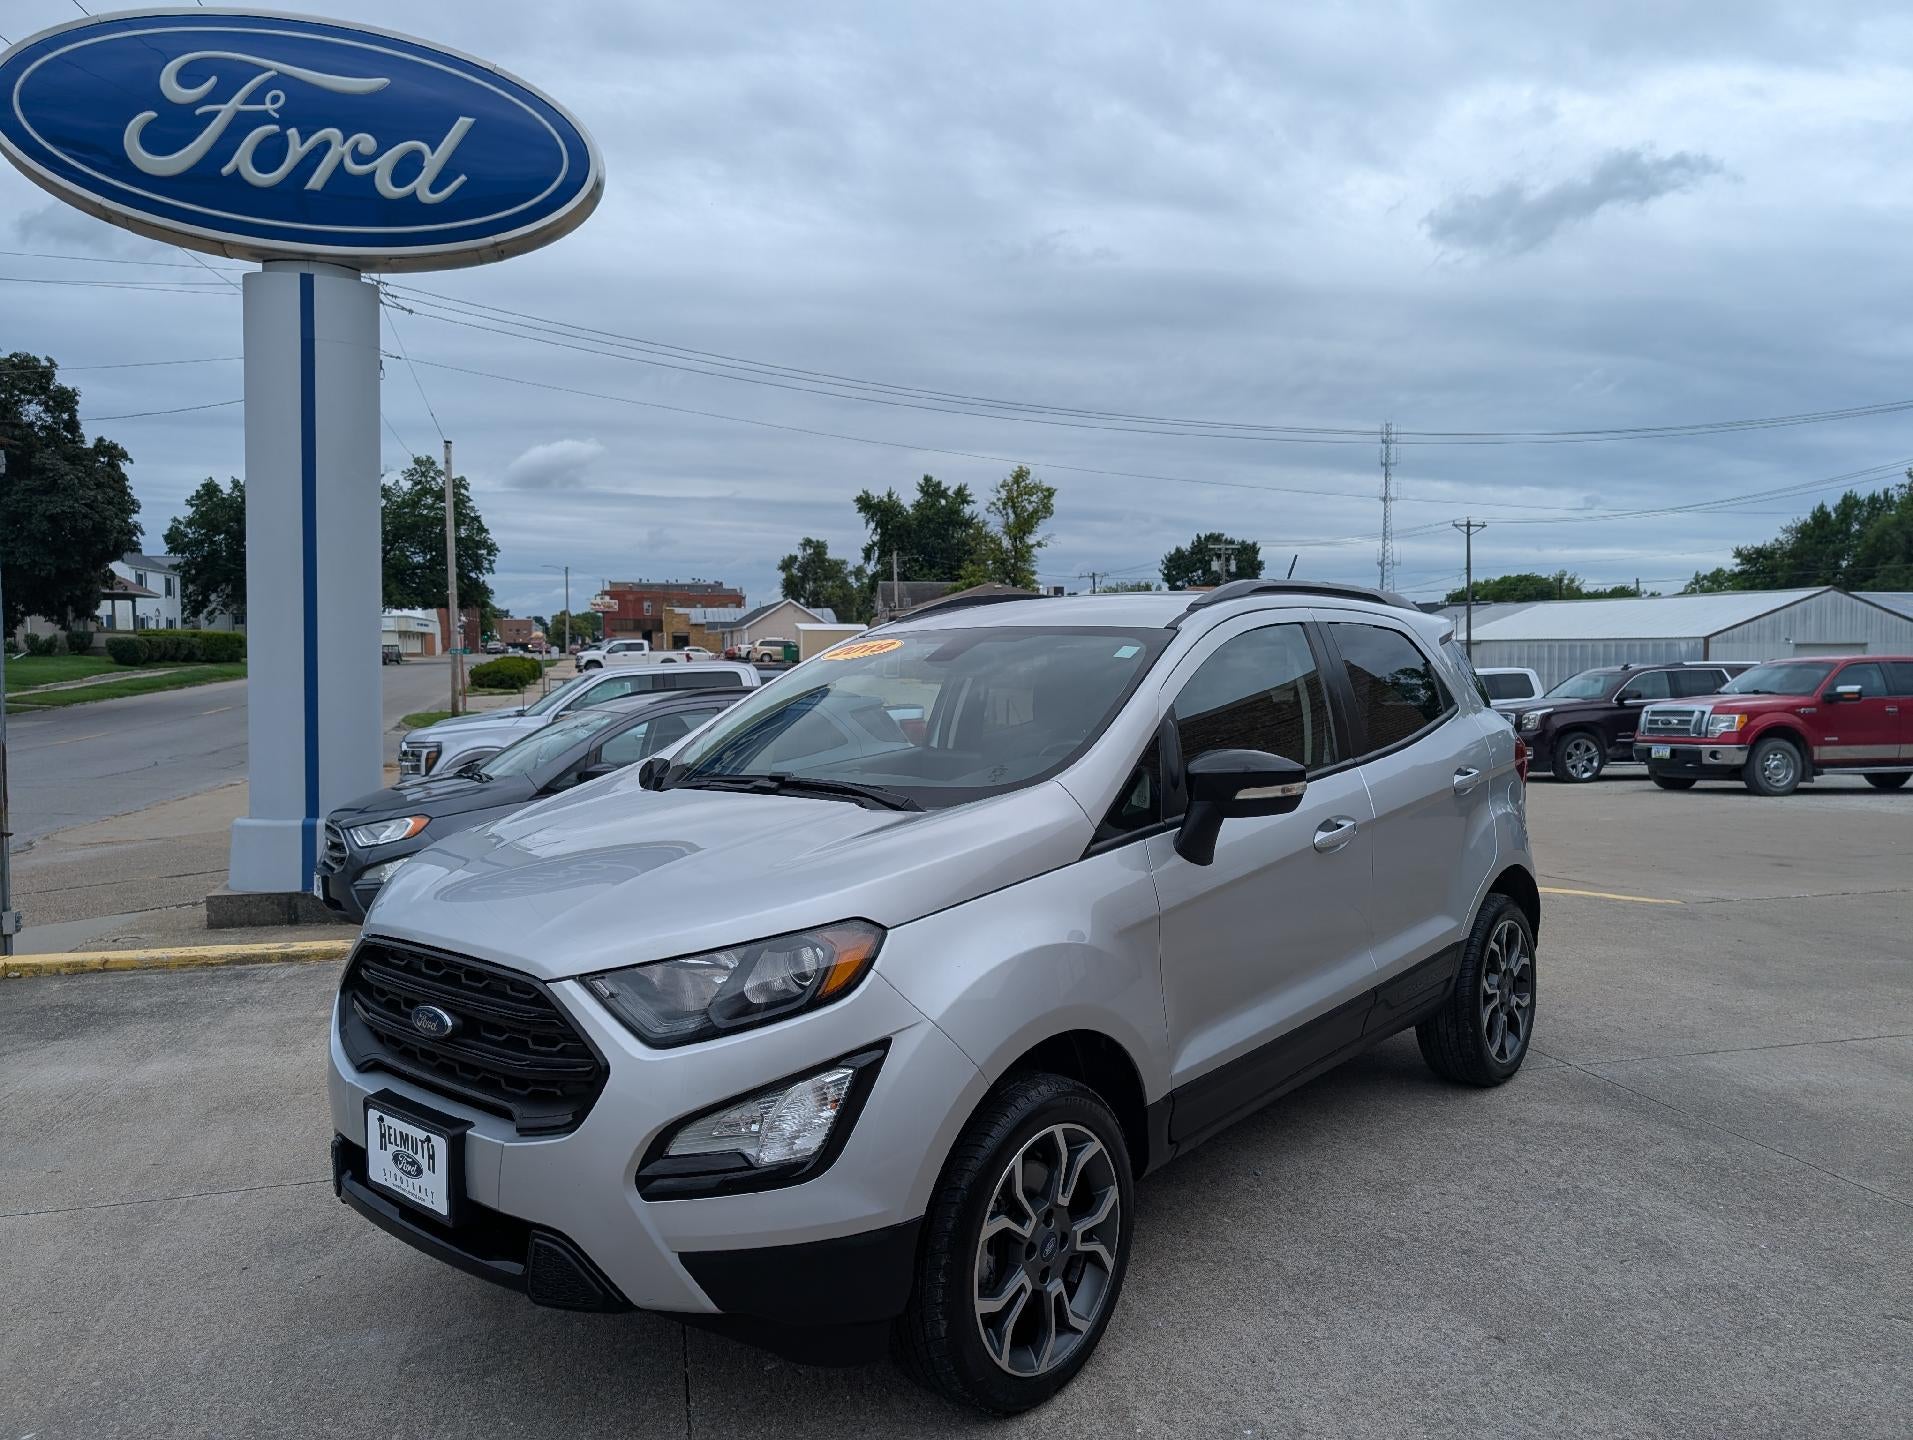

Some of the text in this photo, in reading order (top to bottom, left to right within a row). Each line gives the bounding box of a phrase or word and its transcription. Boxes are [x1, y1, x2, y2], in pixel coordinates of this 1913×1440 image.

[124, 50, 475, 204] Ford
[416, 1010, 439, 1031] Ford
[378, 1119, 436, 1174] HELMUTH
[399, 1154, 418, 1176] Ford
